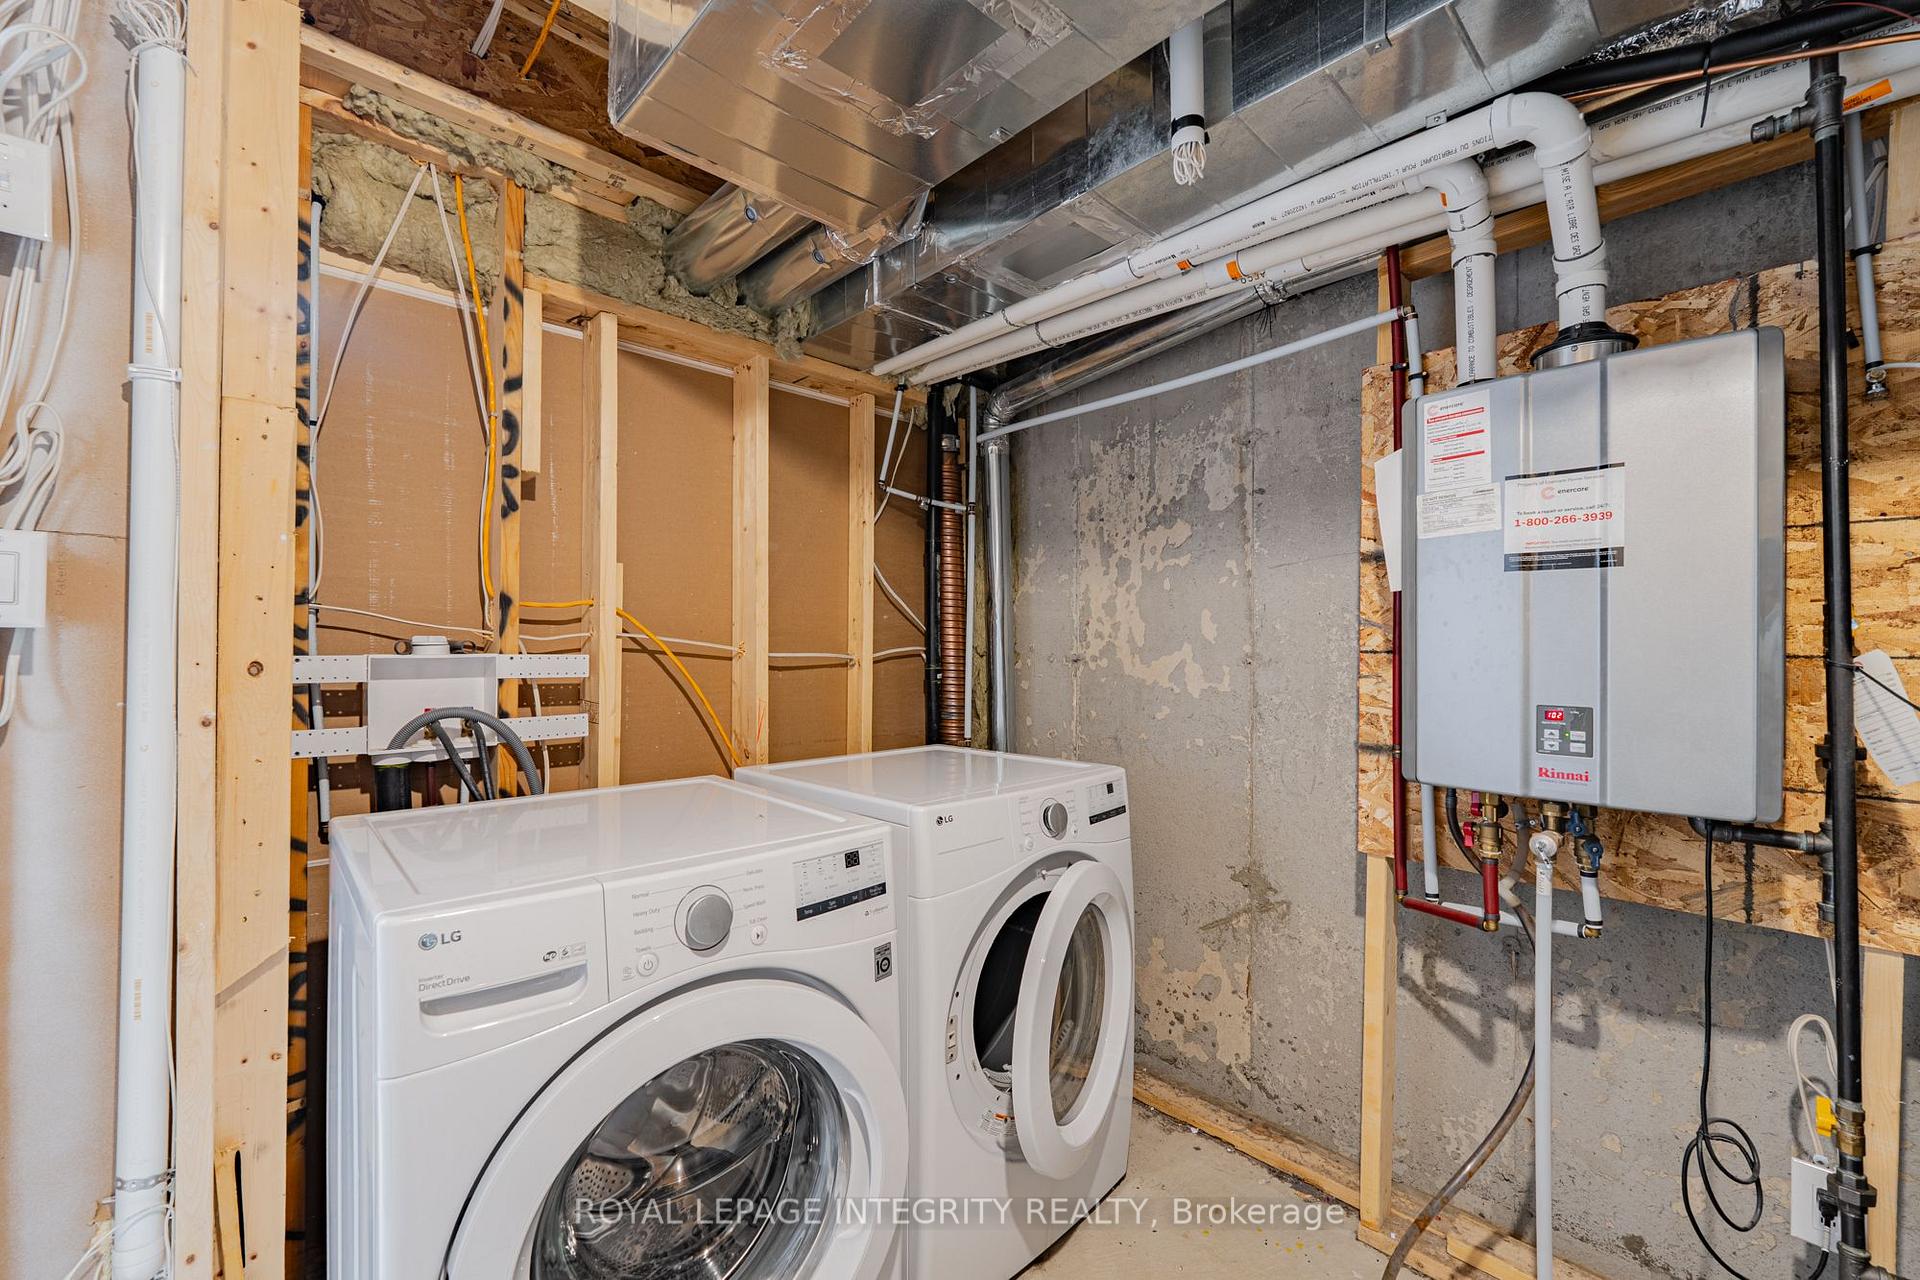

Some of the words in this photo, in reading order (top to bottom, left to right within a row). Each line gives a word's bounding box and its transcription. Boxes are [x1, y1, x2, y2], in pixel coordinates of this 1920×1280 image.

[1753, 65, 1777, 78] LIBRE
[1458, 142, 1469, 151] DU
[1418, 145, 1458, 167] FABRIQUANT
[1400, 161, 1417, 173] POUR
[1560, 168, 1570, 184] MISE
[1567, 213, 1578, 230] LIBRE
[1570, 232, 1580, 243] DES
[1514, 510, 1613, 527] 1-800-266-3939
[1538, 767, 1589, 782] Rinnai
[441, 930, 462, 944] LG
